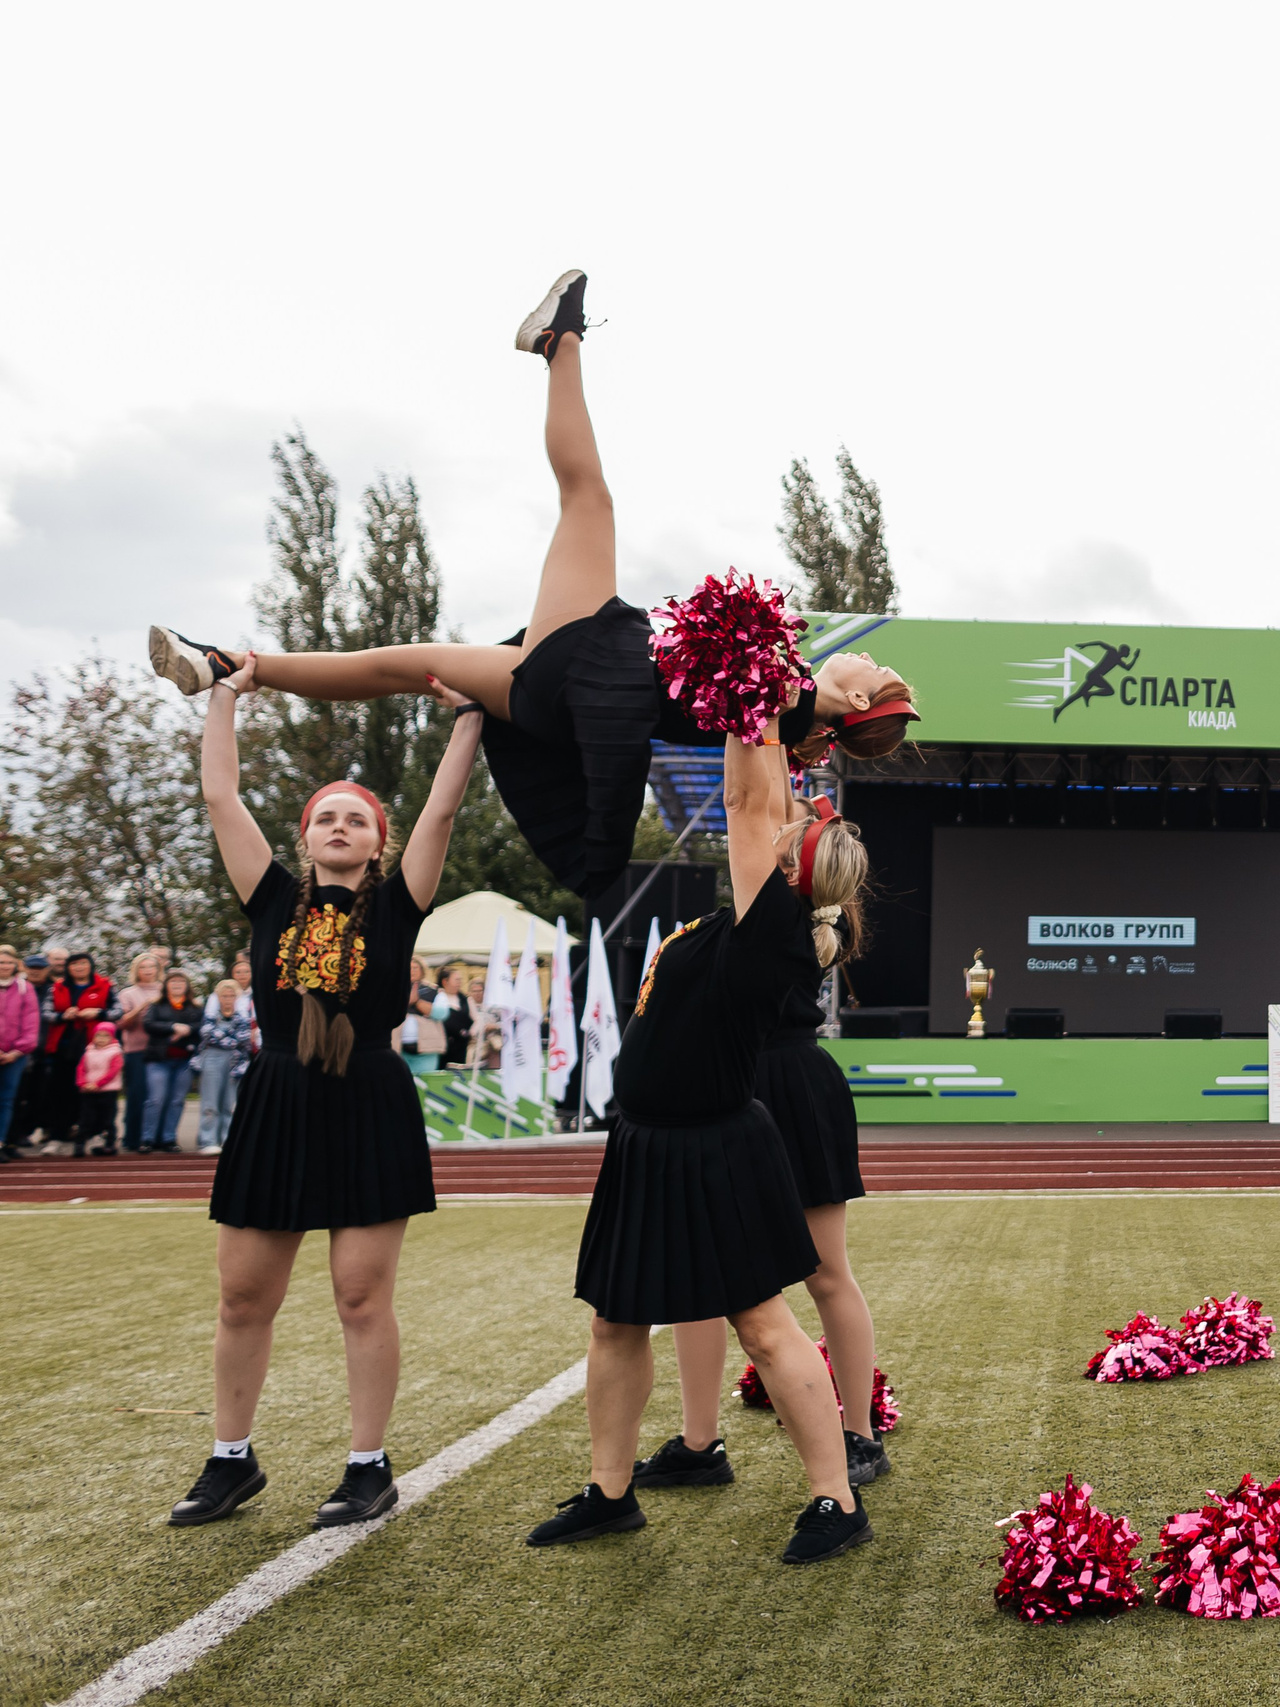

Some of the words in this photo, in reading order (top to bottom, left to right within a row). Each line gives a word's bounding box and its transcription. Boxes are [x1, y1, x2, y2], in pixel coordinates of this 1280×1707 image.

[1120, 676, 1236, 708] СПАРТА
[1188, 711, 1237, 730] КИАДА
[1039, 923, 1114, 938] ВОЛКОВ
[1124, 924, 1184, 938] ГРУПП
